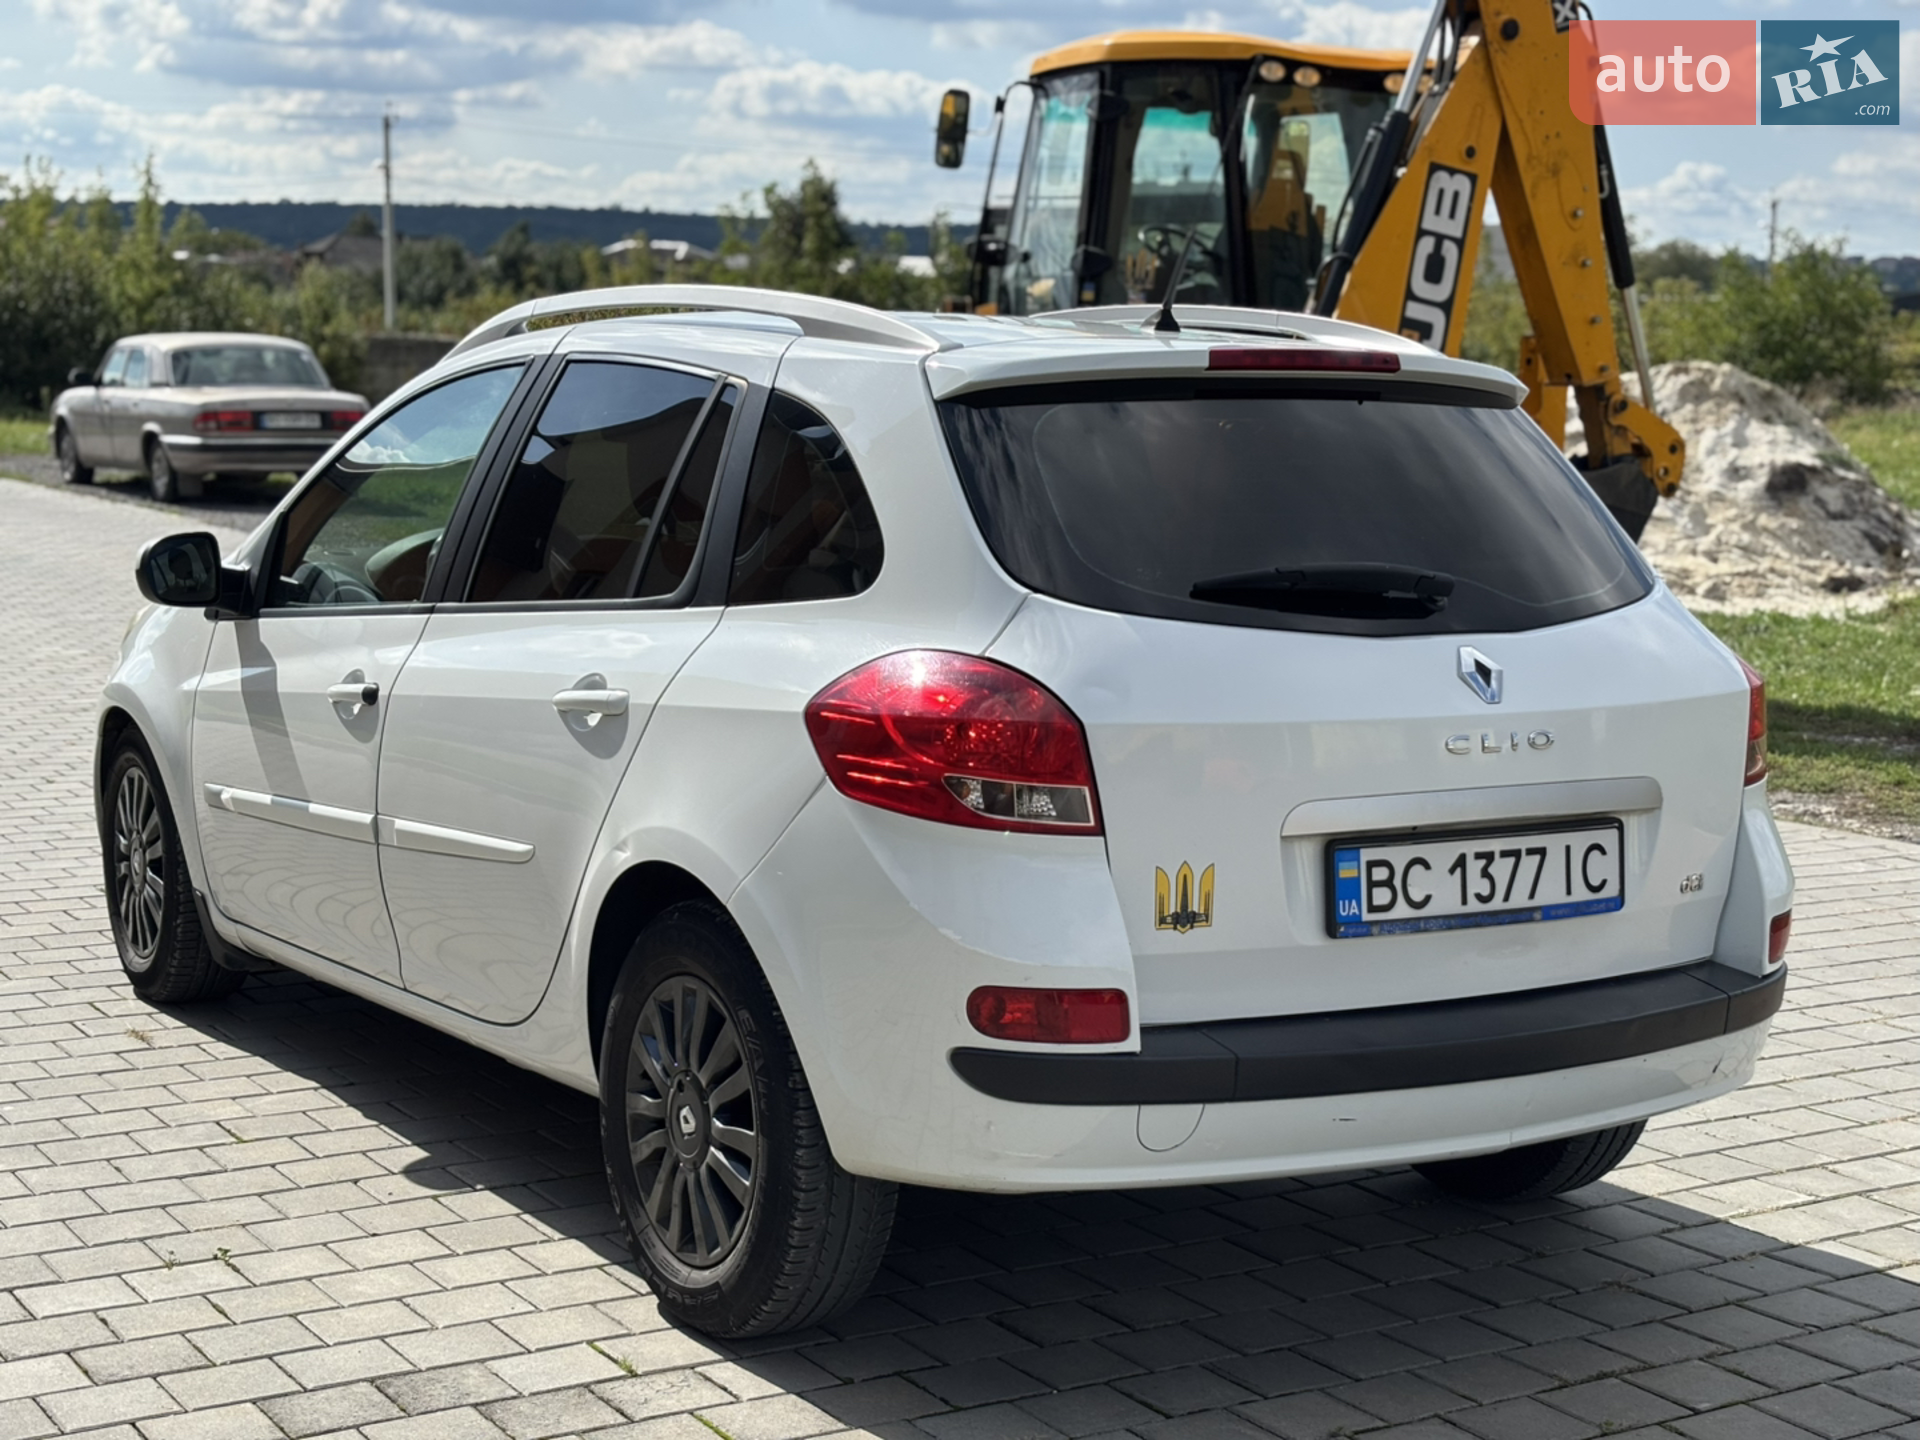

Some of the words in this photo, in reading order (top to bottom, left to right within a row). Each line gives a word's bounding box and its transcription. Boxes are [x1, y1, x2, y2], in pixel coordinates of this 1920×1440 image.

[1404, 169, 1473, 355] JCB
[1445, 729, 1555, 755] CLIO
[1365, 856, 1433, 914] BC
[1447, 846, 1547, 906] 1377
[1565, 842, 1608, 896] IC
[1339, 898, 1360, 916] UA
